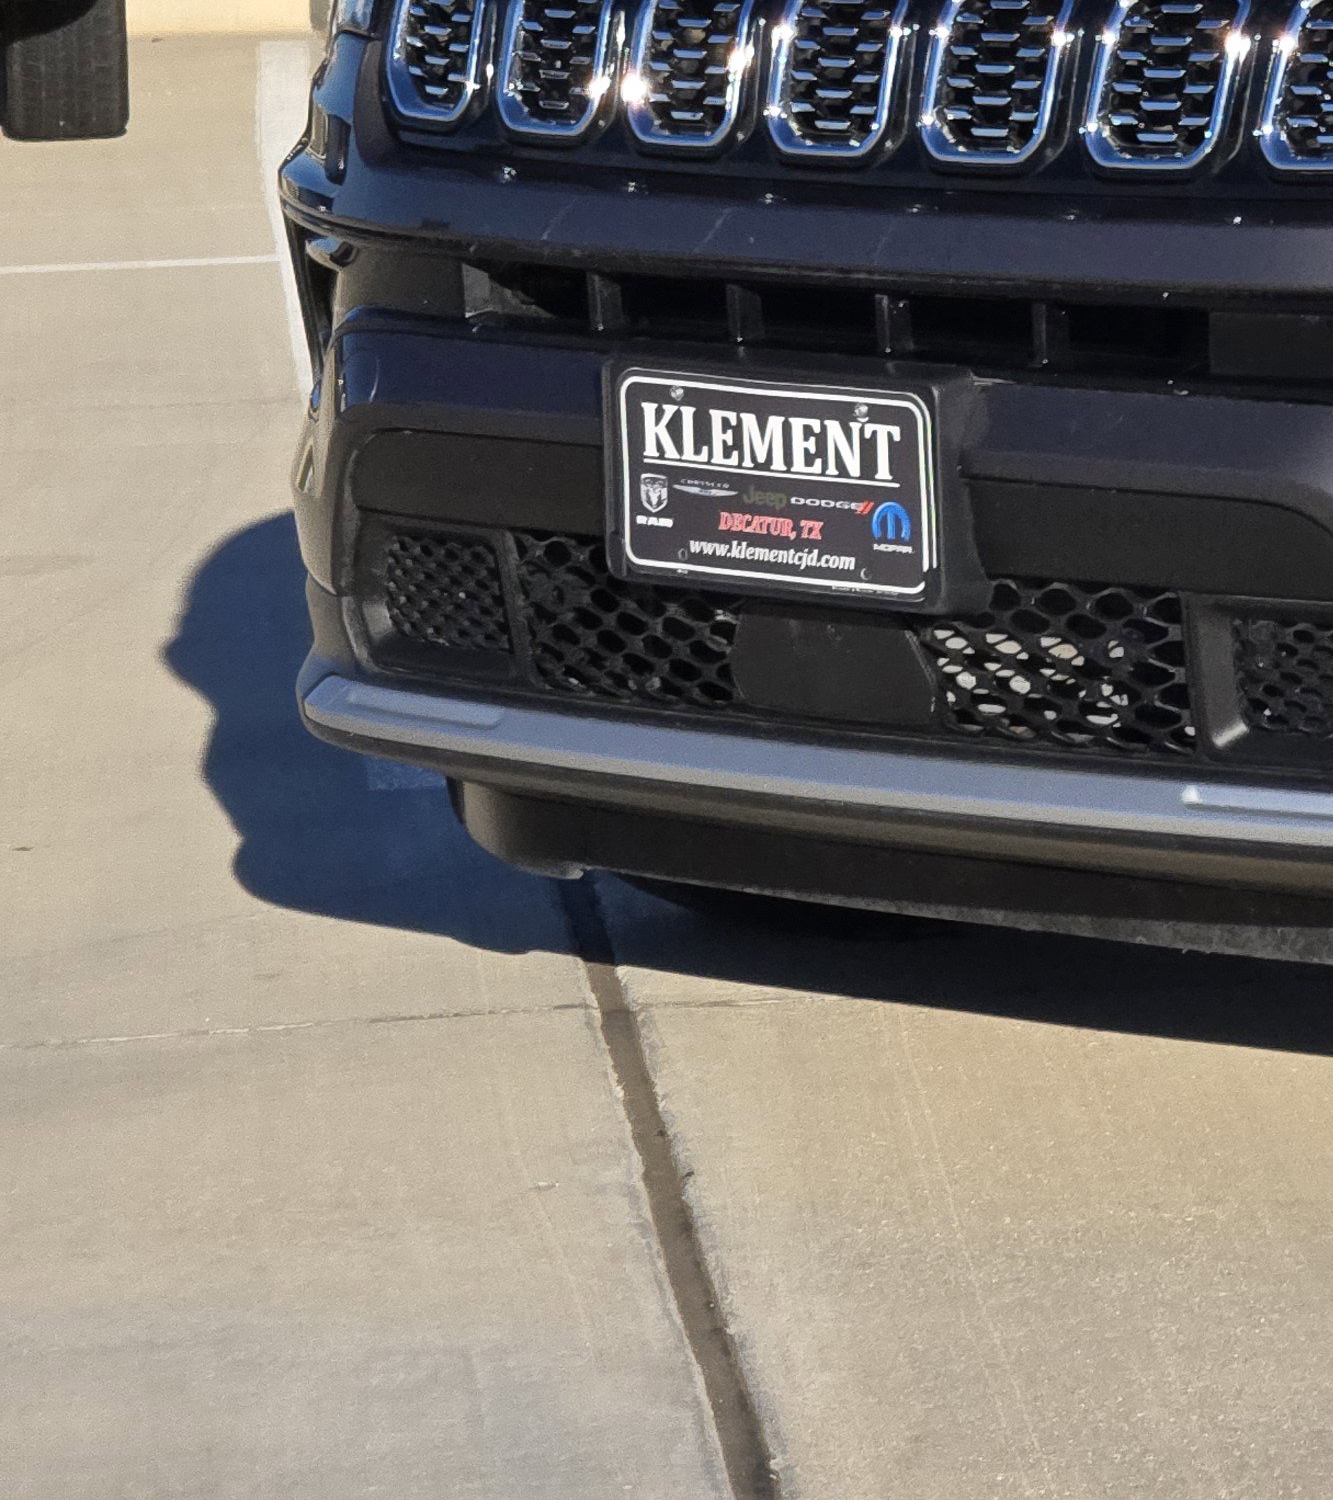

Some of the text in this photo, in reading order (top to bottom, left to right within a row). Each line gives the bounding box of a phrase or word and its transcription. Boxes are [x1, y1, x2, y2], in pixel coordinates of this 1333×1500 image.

[640, 401, 901, 481] KLEMENT
[790, 496, 862, 511] DODGE
[718, 511, 824, 541] DECATUR, TX
[689, 538, 856, 571] www.klementcjd.com
